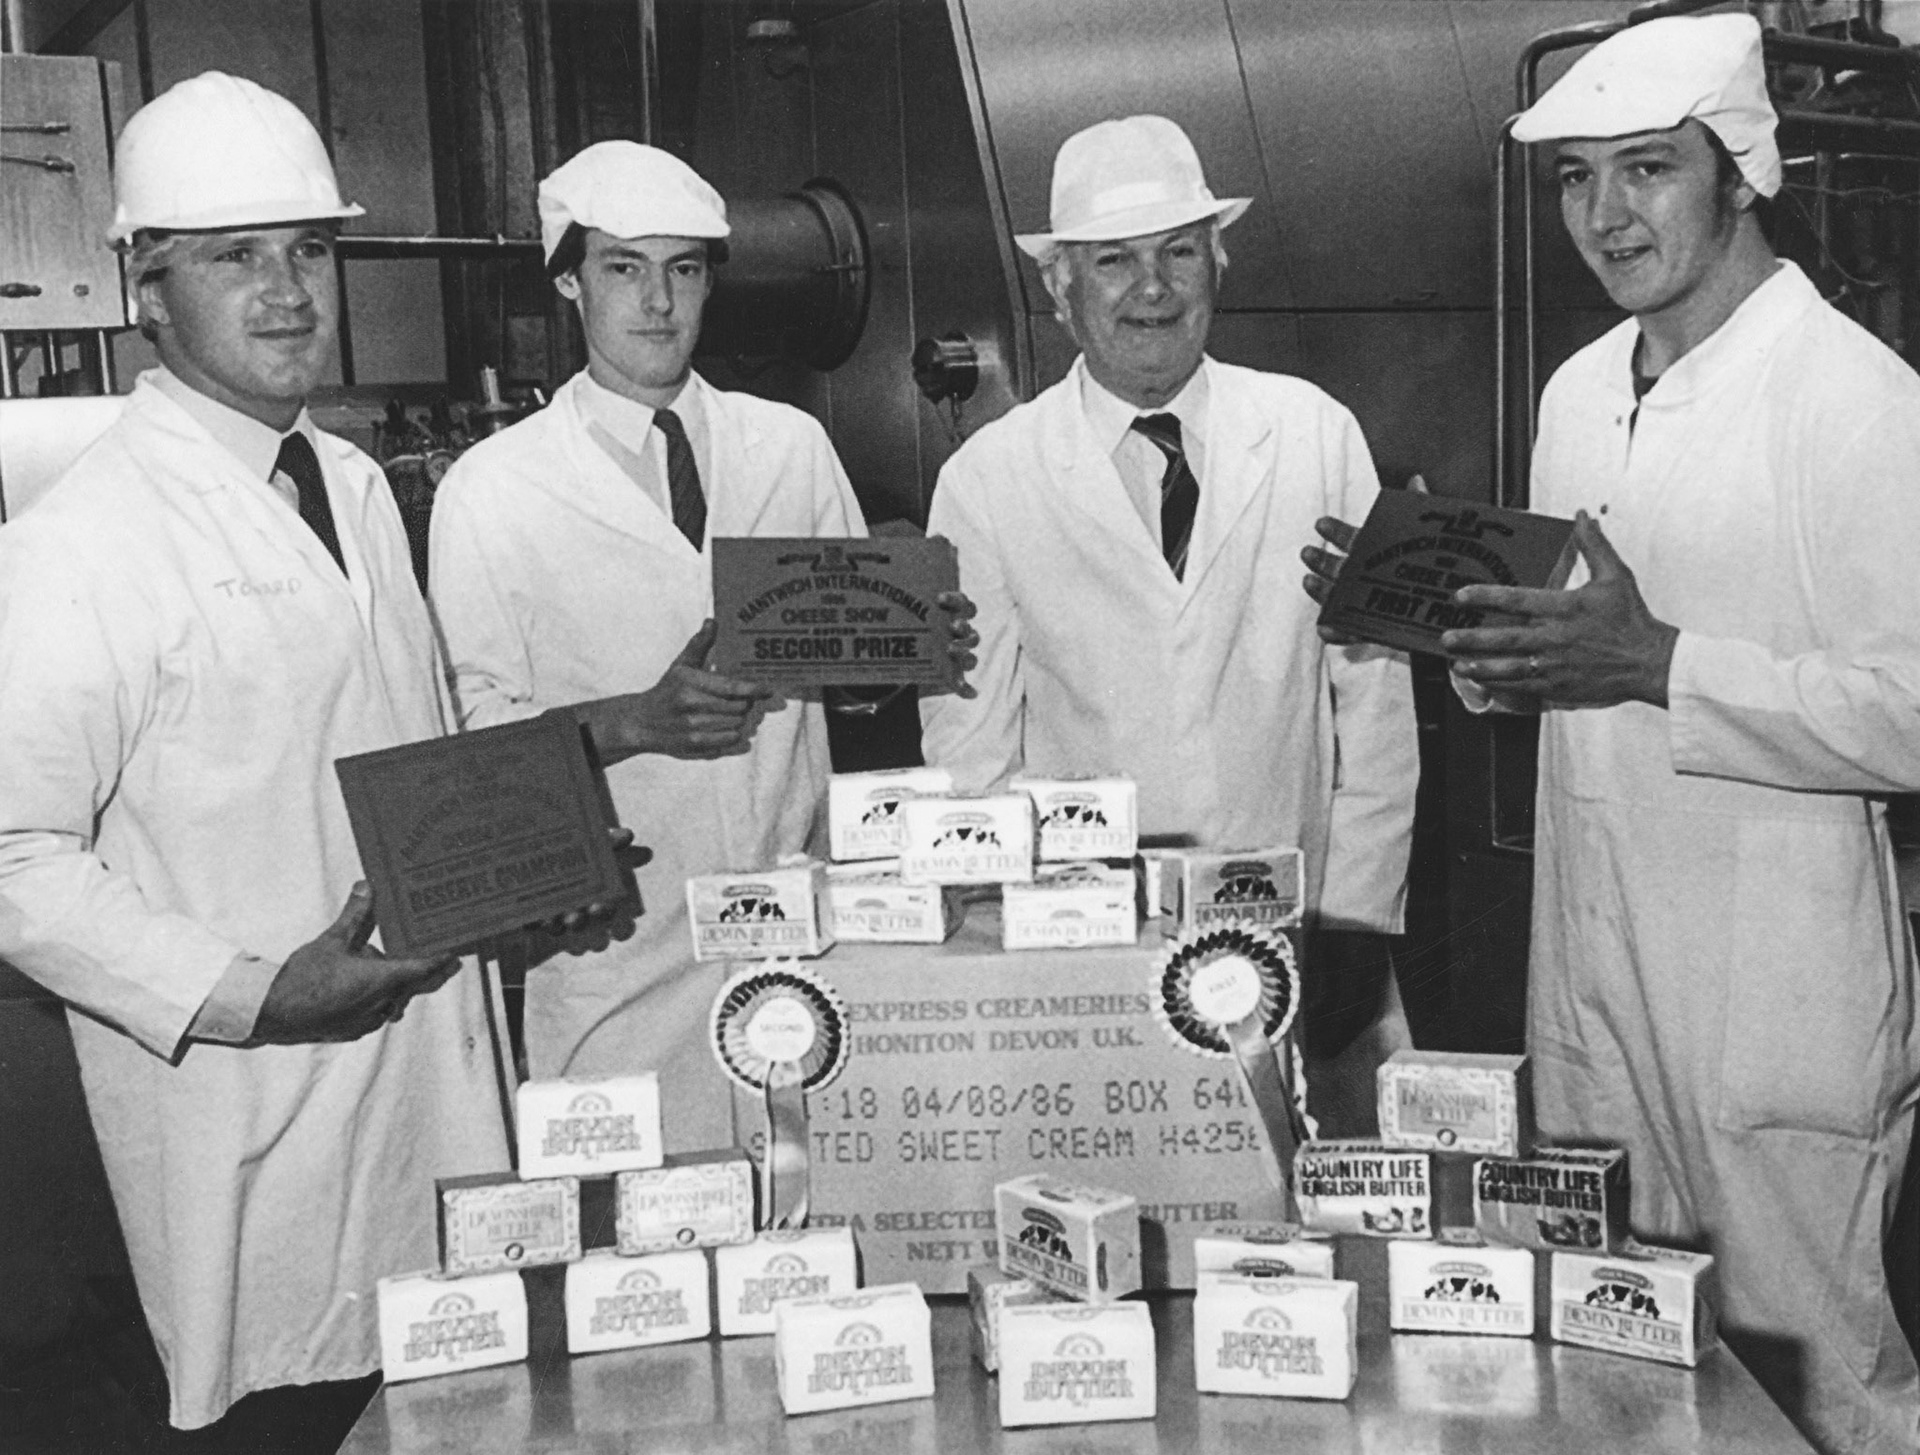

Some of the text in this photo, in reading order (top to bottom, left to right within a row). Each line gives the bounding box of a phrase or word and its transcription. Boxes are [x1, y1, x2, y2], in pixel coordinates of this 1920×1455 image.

[814, 574, 929, 622] INTERNATIONAL
[1366, 588, 1423, 617] FIRST
[781, 607, 889, 624] CHEESE SHOW
[755, 637, 918, 660] SECOND PRIZE
[702, 925, 808, 943] DEVON BUTTER
[849, 994, 1150, 1021] EXPRESS CREAMERIES
[856, 1027, 1143, 1055] HONITON DEVON U.K.
[902, 1082, 1074, 1119] 04/08/86
[1105, 1080, 1168, 1115] BOX
[547, 1115, 634, 1139] DEVON
[541, 1134, 641, 1158] BUTTER
[752, 1132, 873, 1163] STED
[899, 1129, 1003, 1161] SWEET
[1027, 1127, 1136, 1160] CREAM
[1301, 1159, 1425, 1179] COUNTRY LIFE
[1481, 1161, 1602, 1194] COUNTRY LIFE
[1302, 1180, 1427, 1198] ENGLISH BUTTER
[1479, 1183, 1603, 1213] ENGLISH BUTTER
[907, 1240, 971, 1262] NETT
[743, 1275, 830, 1299] DEVON
[596, 1289, 682, 1316] DEVON
[1459, 1306, 1526, 1326] BUTTER
[409, 1310, 499, 1344] DEVON
[589, 1307, 689, 1335] BUTTER
[1563, 1303, 1682, 1345] DEVON BUTTER
[403, 1330, 506, 1362] BUTTER
[1221, 1331, 1317, 1356] DEVON
[814, 1345, 906, 1373] DEVON
[1031, 1360, 1127, 1382] DEVON
[1216, 1348, 1325, 1377] BUTTER
[807, 1364, 914, 1394] BUTTER
[1023, 1379, 1134, 1404] BUTTER
